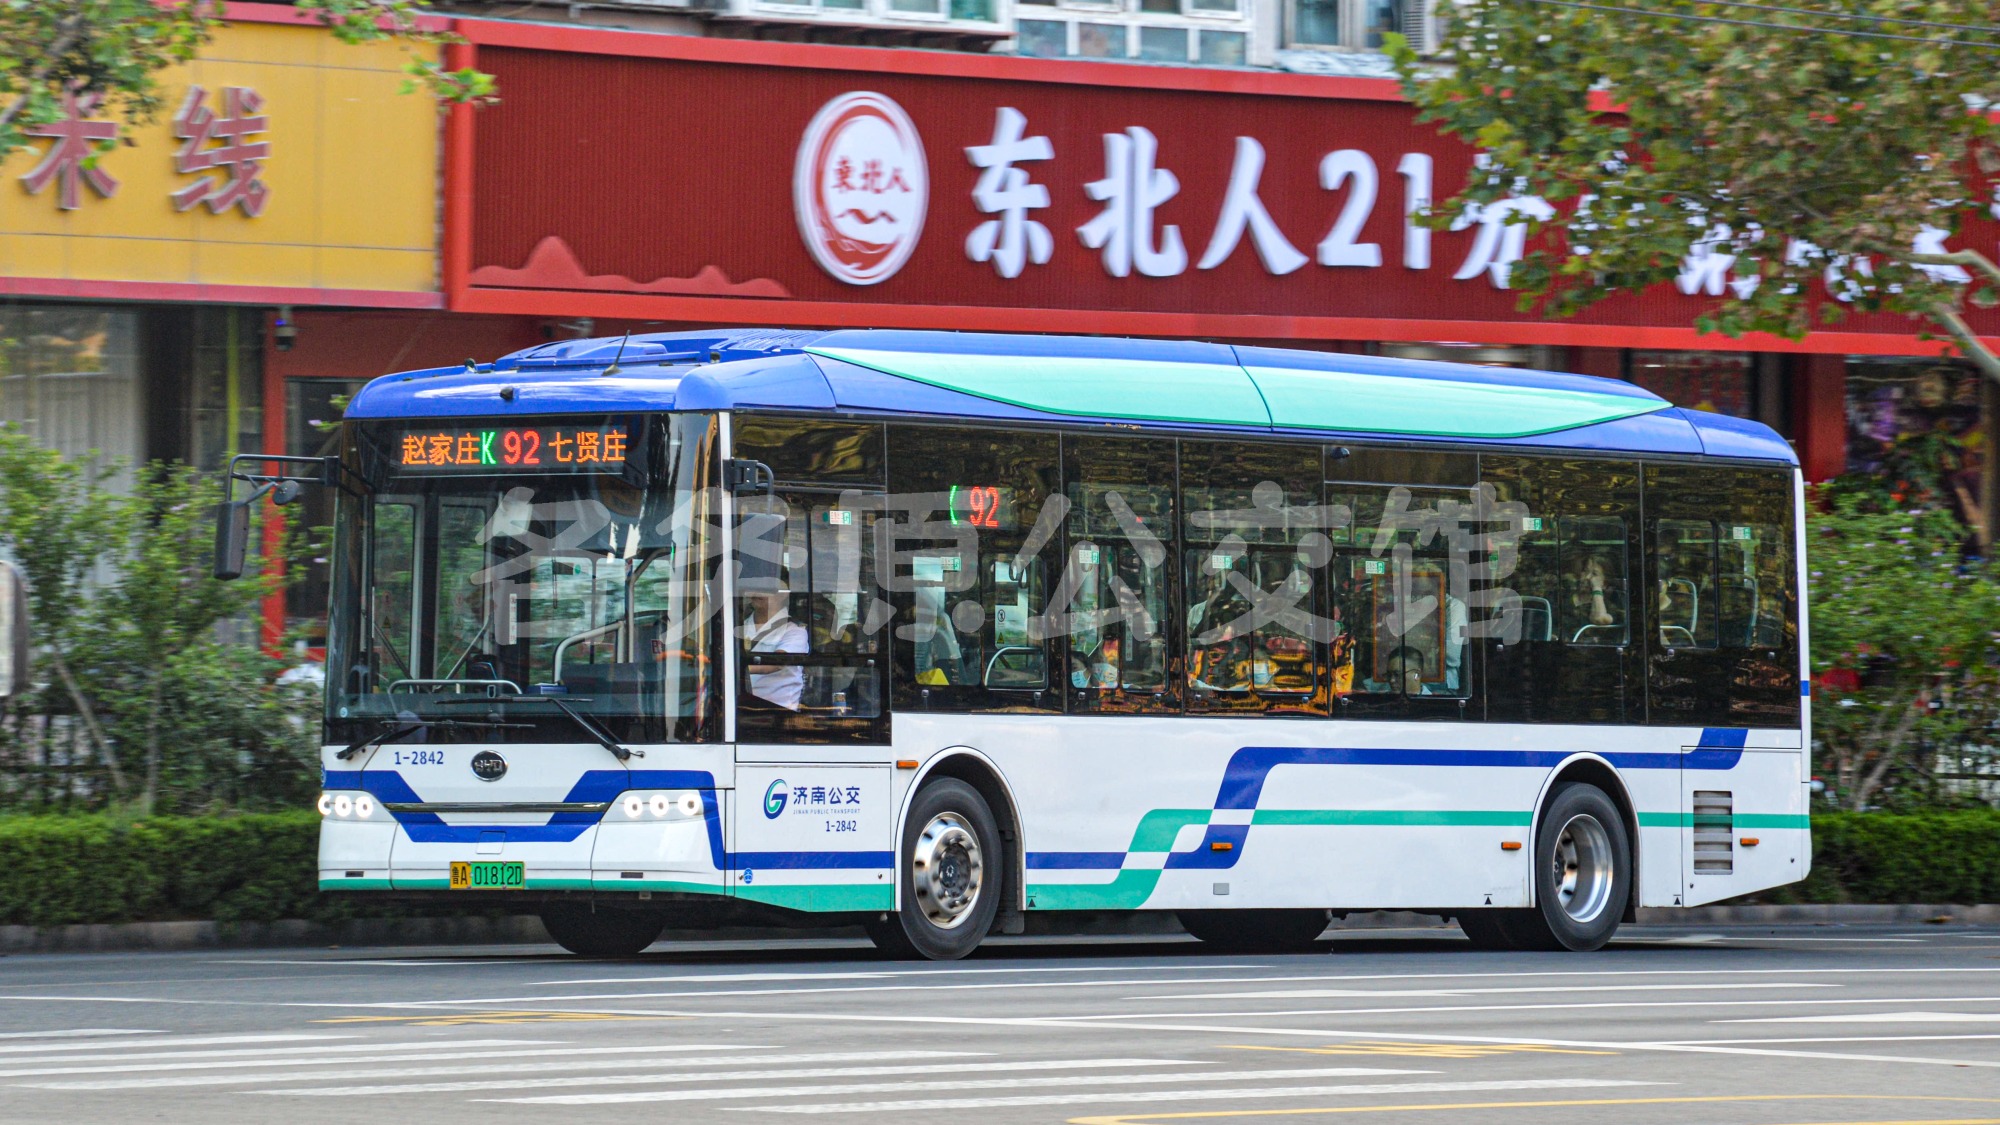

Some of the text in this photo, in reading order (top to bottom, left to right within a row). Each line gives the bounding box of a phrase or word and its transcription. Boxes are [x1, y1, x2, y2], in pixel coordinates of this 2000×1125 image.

[548, 430, 627, 463] 七贤庄
[394, 751, 444, 765] 1-2842
[793, 786, 861, 805] 济南公交
[825, 820, 857, 832] 1-2842
